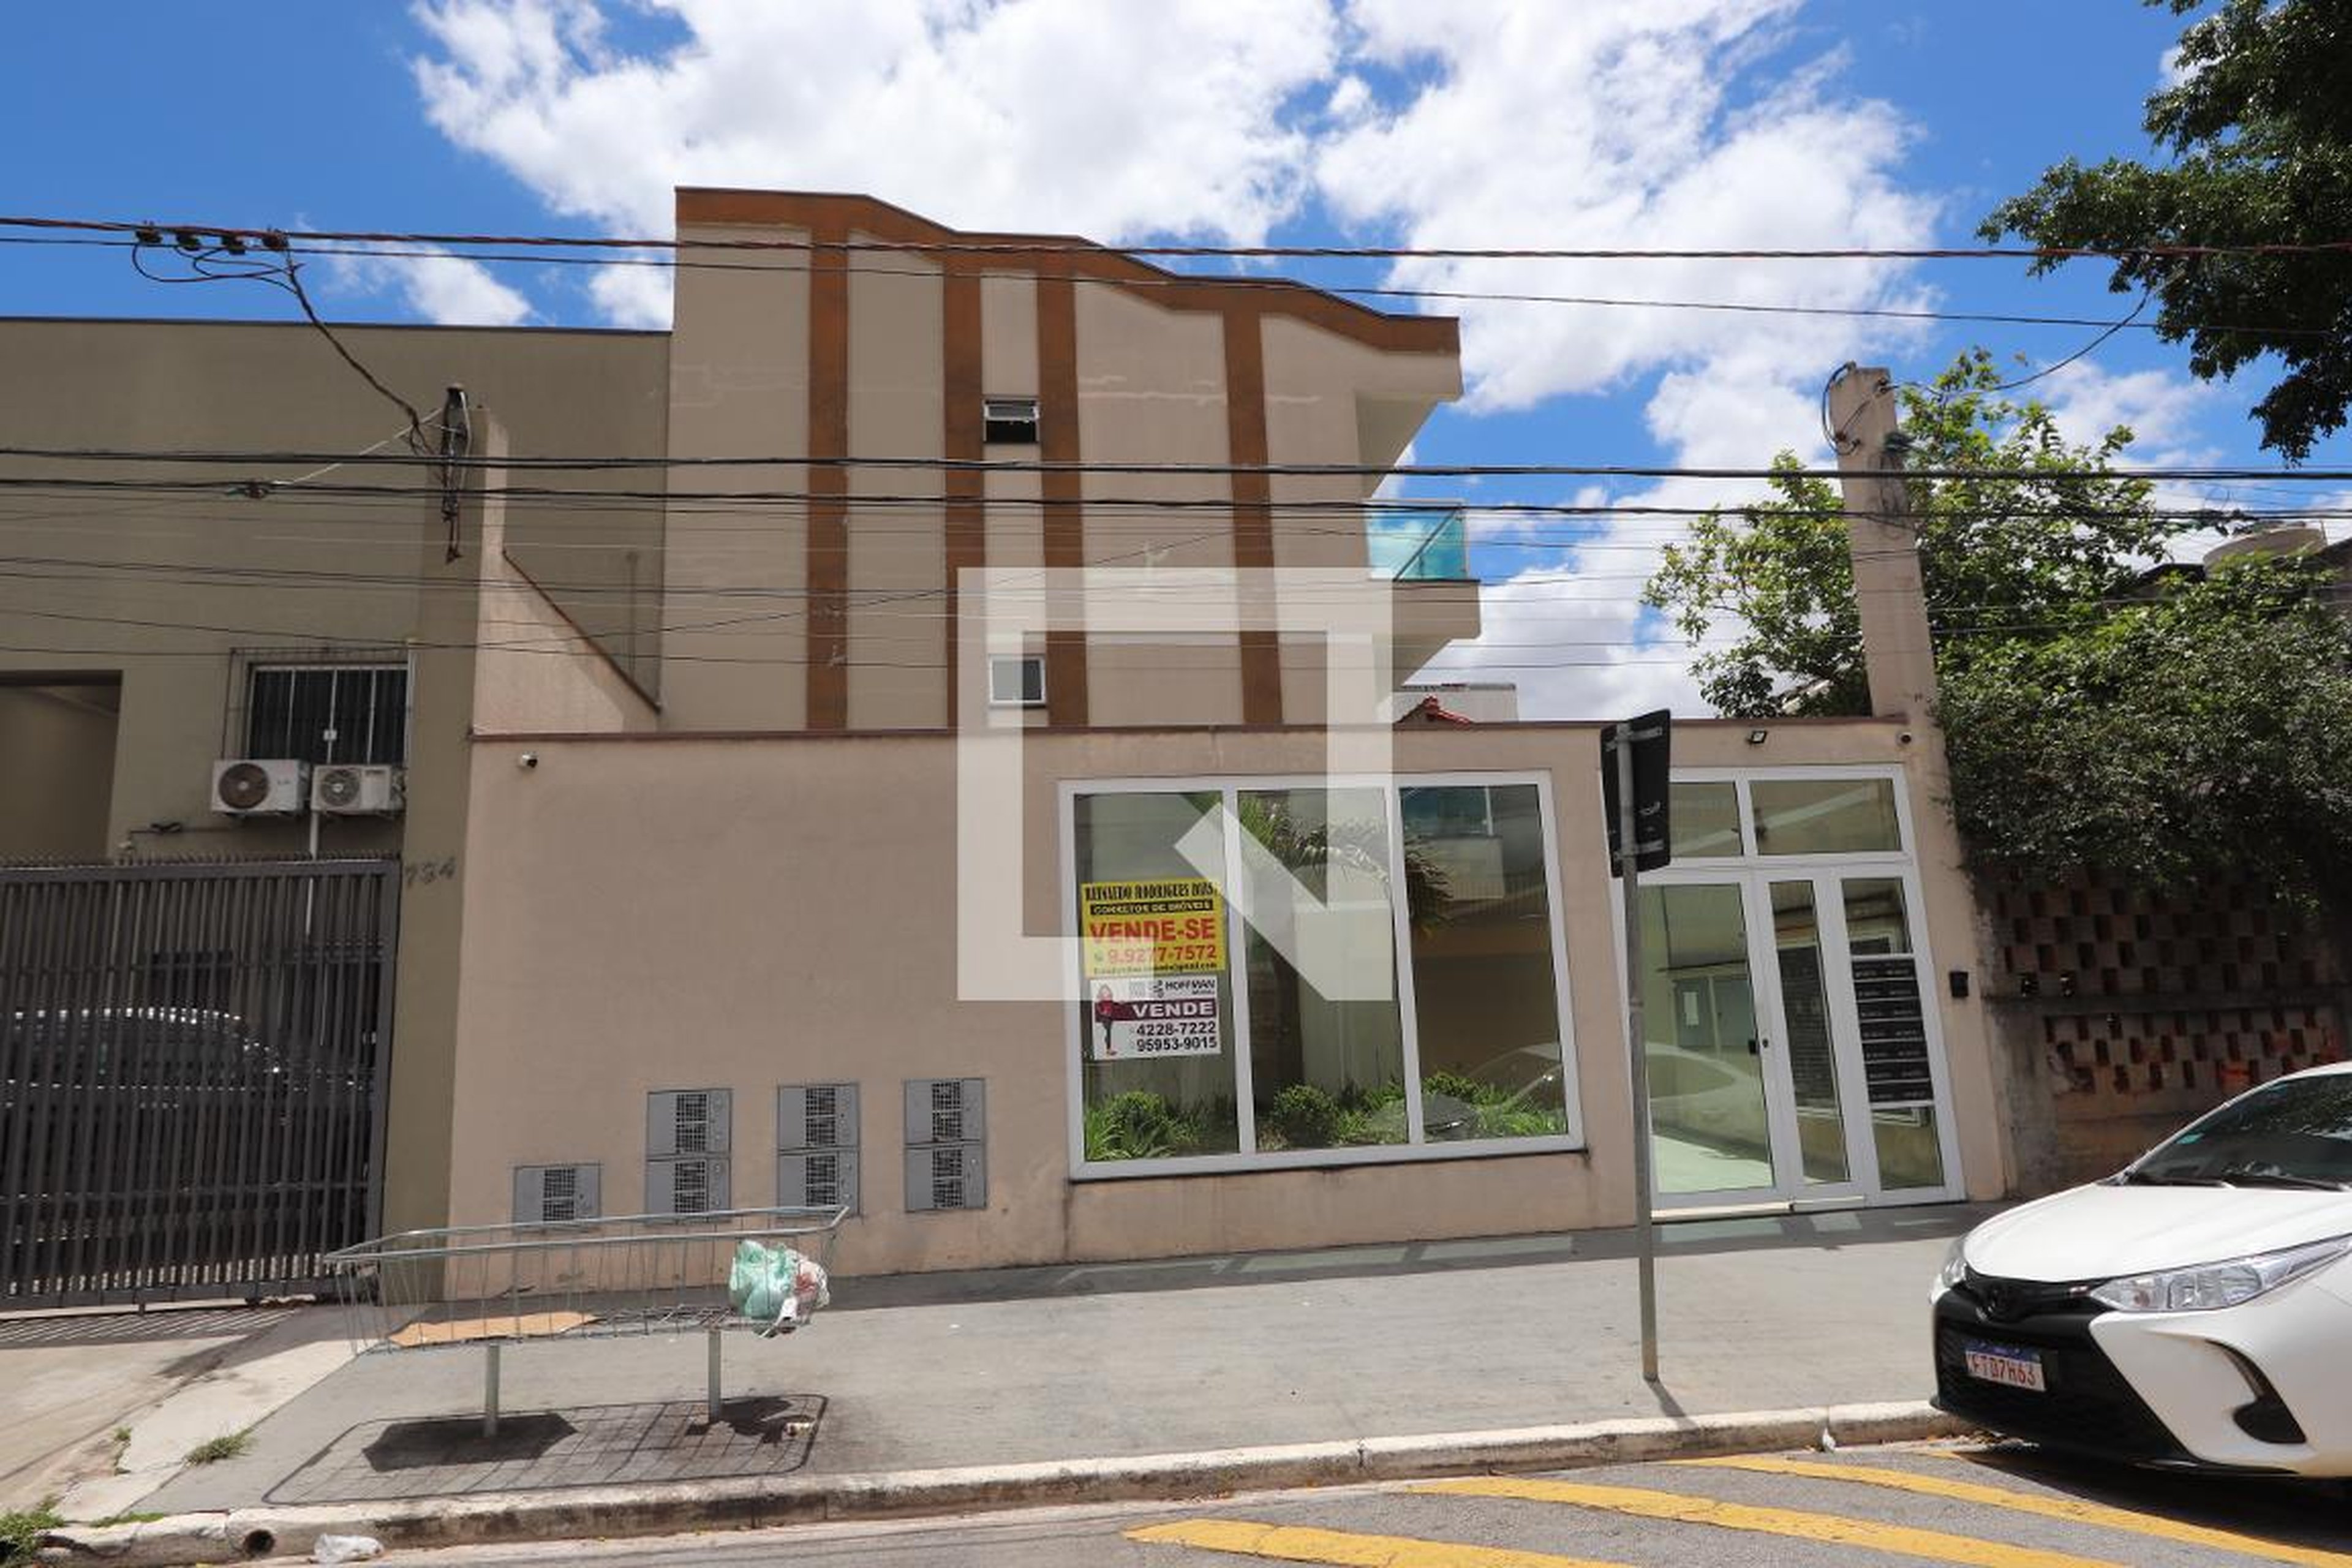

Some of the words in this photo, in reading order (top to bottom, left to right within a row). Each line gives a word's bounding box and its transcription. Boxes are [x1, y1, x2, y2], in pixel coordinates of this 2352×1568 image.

[1090, 919, 1216, 943] VENDE-SE
[1133, 1001, 1214, 1017] VENDE
[1137, 1022, 1216, 1036] 4228-7222
[1137, 1036, 1217, 1052] 95953-9015
